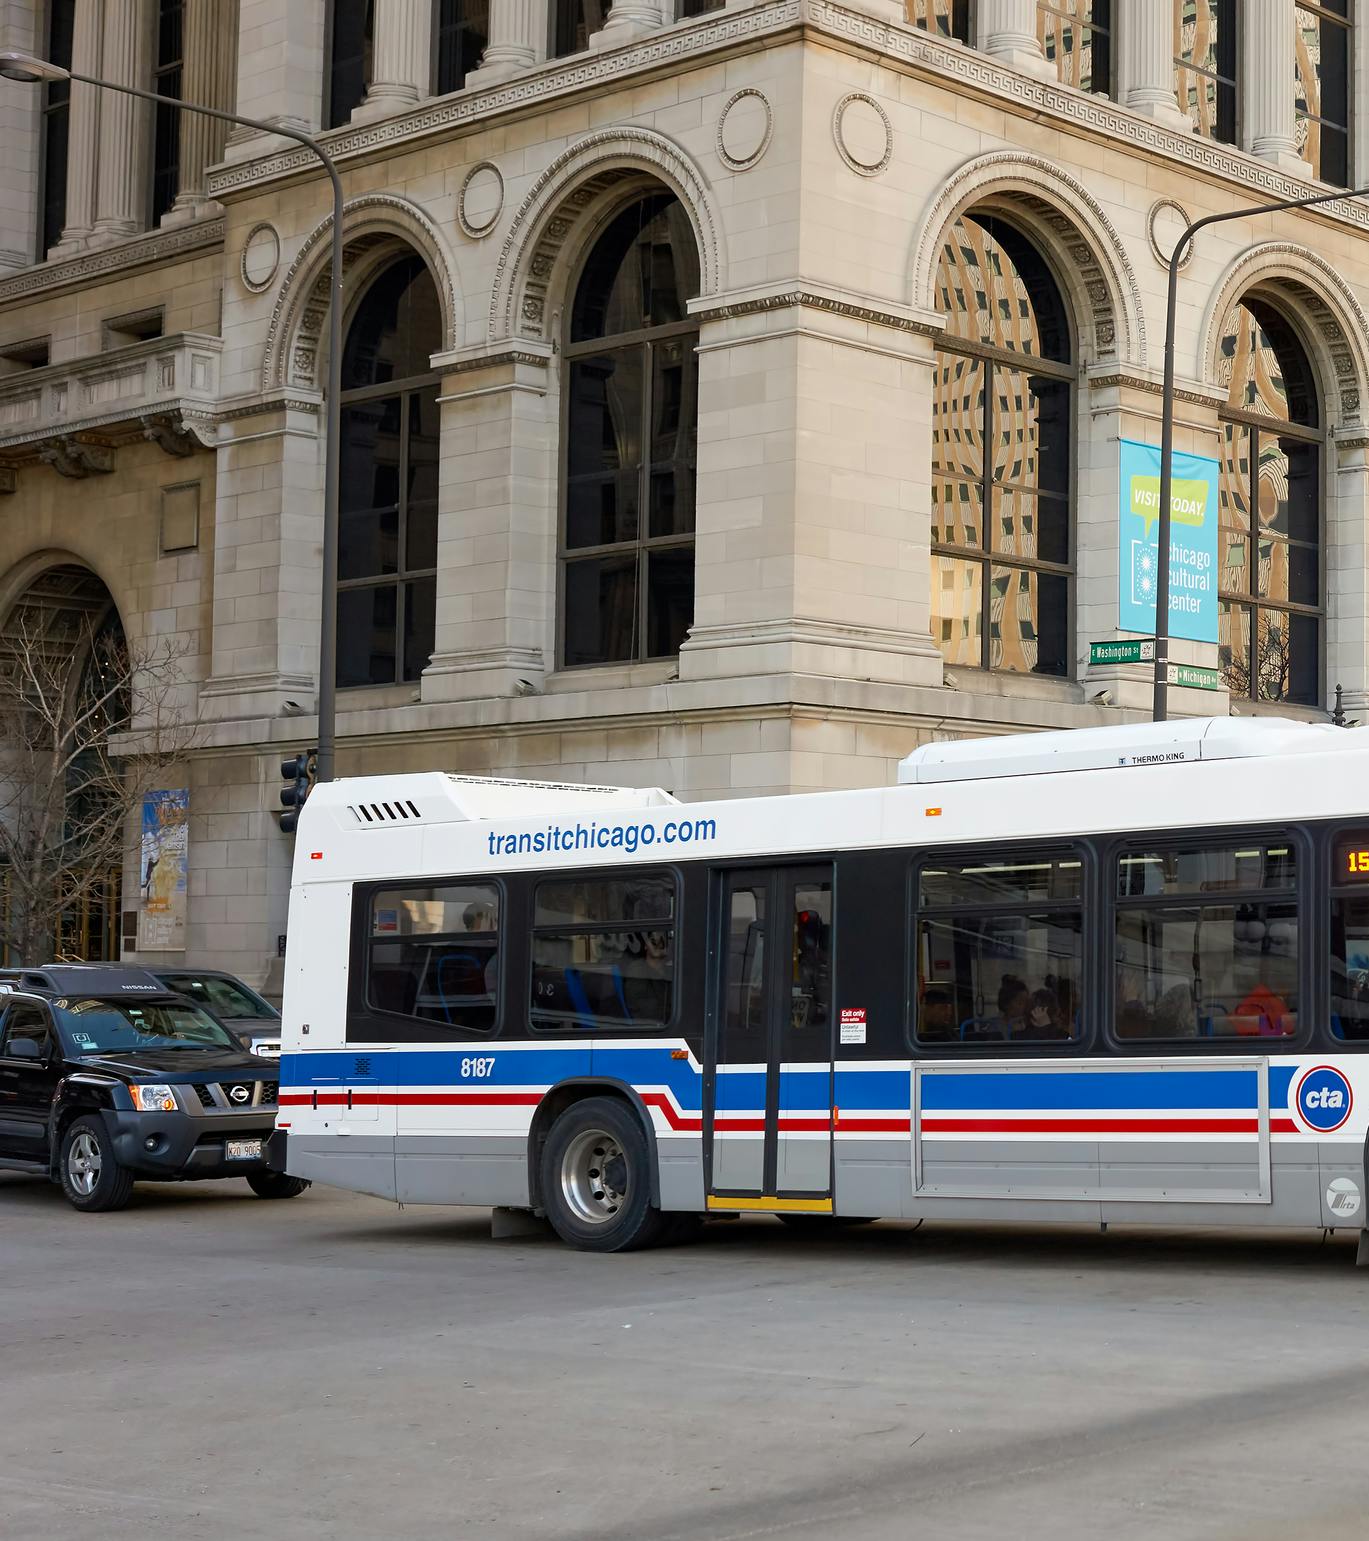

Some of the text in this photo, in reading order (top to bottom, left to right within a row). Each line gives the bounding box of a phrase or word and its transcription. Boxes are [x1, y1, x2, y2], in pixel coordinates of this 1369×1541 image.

[1096, 645, 1132, 660] Washington
[1183, 669, 1211, 687] Michigan
[1132, 752, 1185, 764] THERMO KING
[488, 819, 716, 855] transitchicago.com
[852, 1010, 865, 1018] only
[461, 1057, 496, 1078] 8187
[1305, 1087, 1344, 1109] cta
